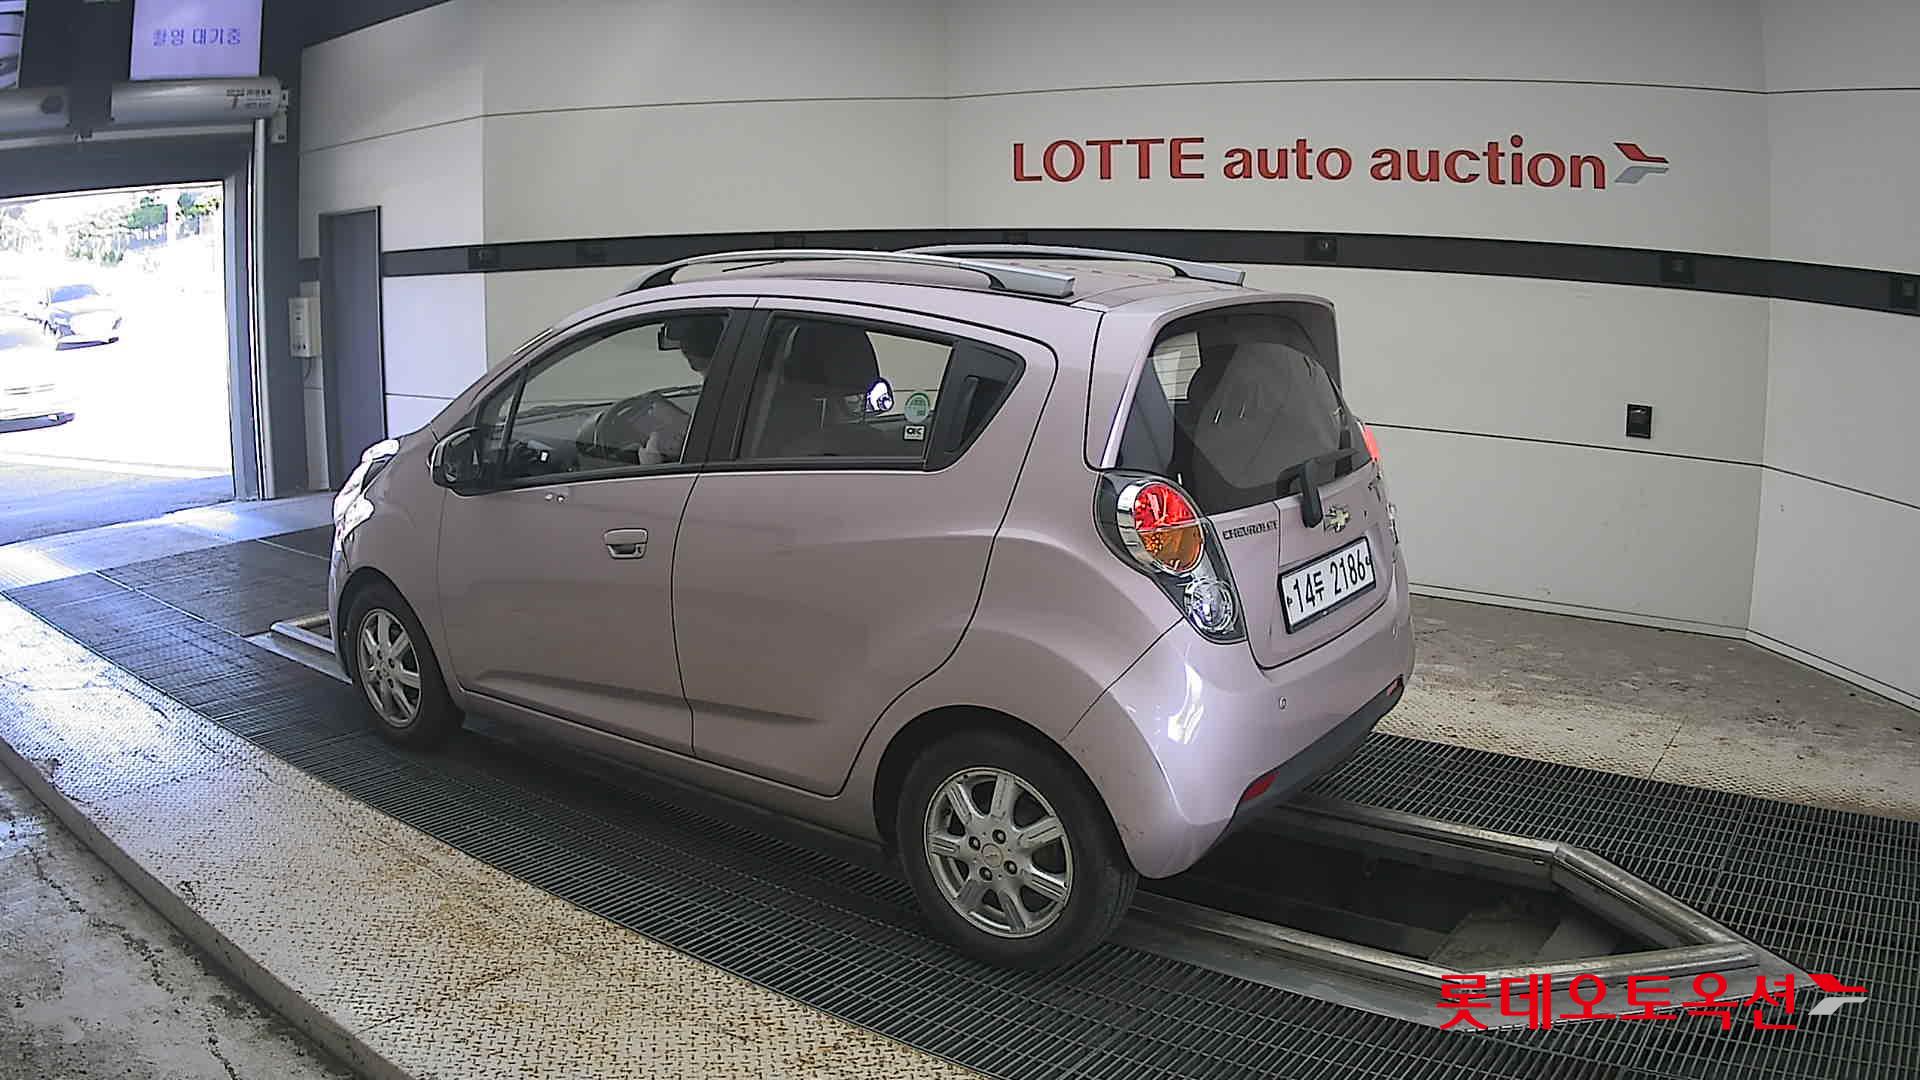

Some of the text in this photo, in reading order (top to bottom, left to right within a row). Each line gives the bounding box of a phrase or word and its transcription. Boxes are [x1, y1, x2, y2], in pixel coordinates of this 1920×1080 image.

[1013, 134, 1606, 190] LOTTE auto auction
[1222, 519, 1278, 540] CHEVROLET
[1293, 549, 1366, 613] 14두 2186
